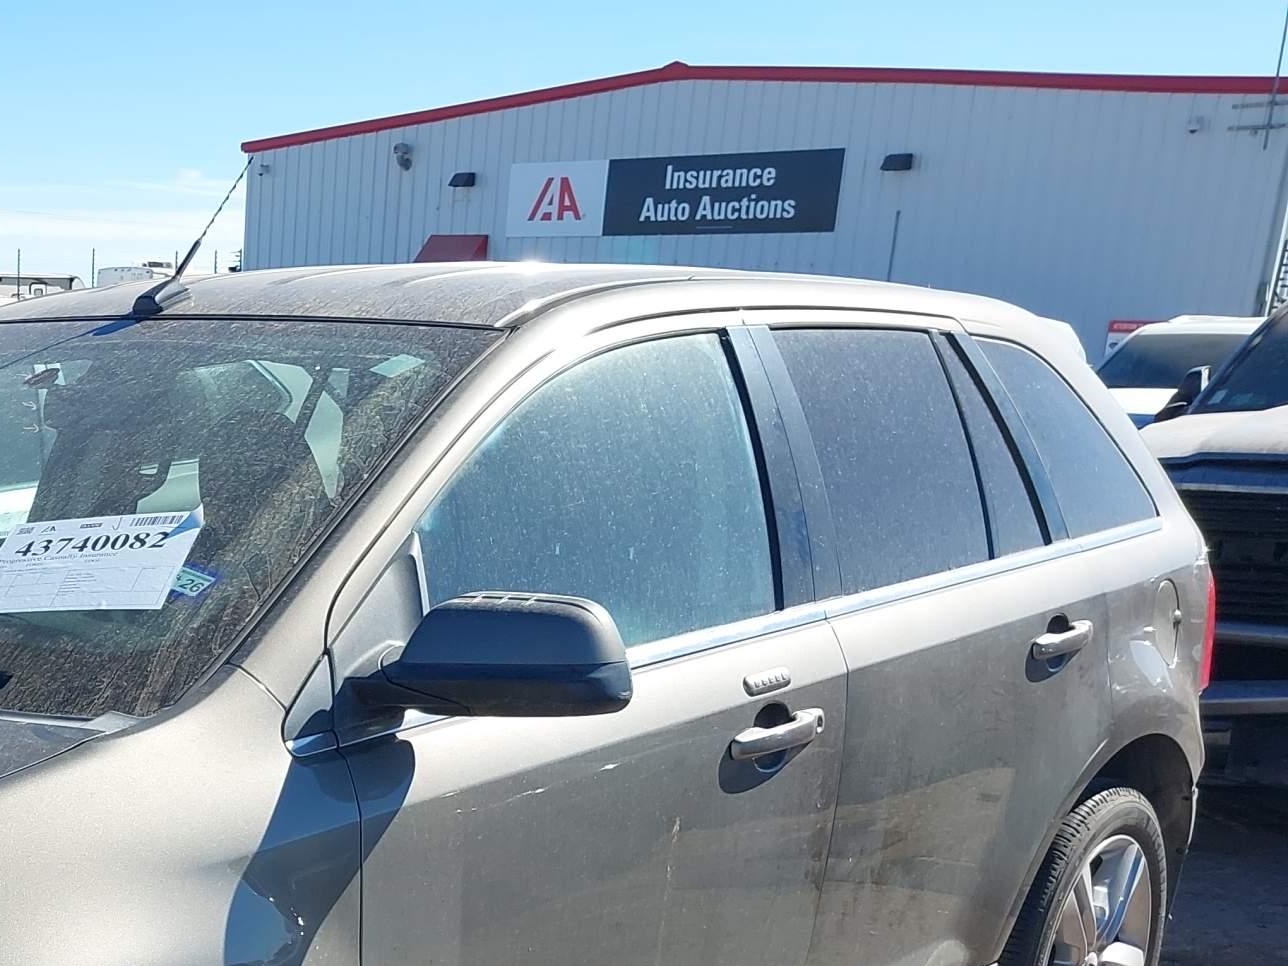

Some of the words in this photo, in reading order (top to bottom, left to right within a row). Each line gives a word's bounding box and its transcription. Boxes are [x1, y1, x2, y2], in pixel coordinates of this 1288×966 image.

[665, 165, 776, 189] Insurance
[639, 197, 690, 222] Auto
[695, 194, 796, 220] Auctions
[15, 531, 170, 557] 43740082
[178, 578, 205, 593] 26
